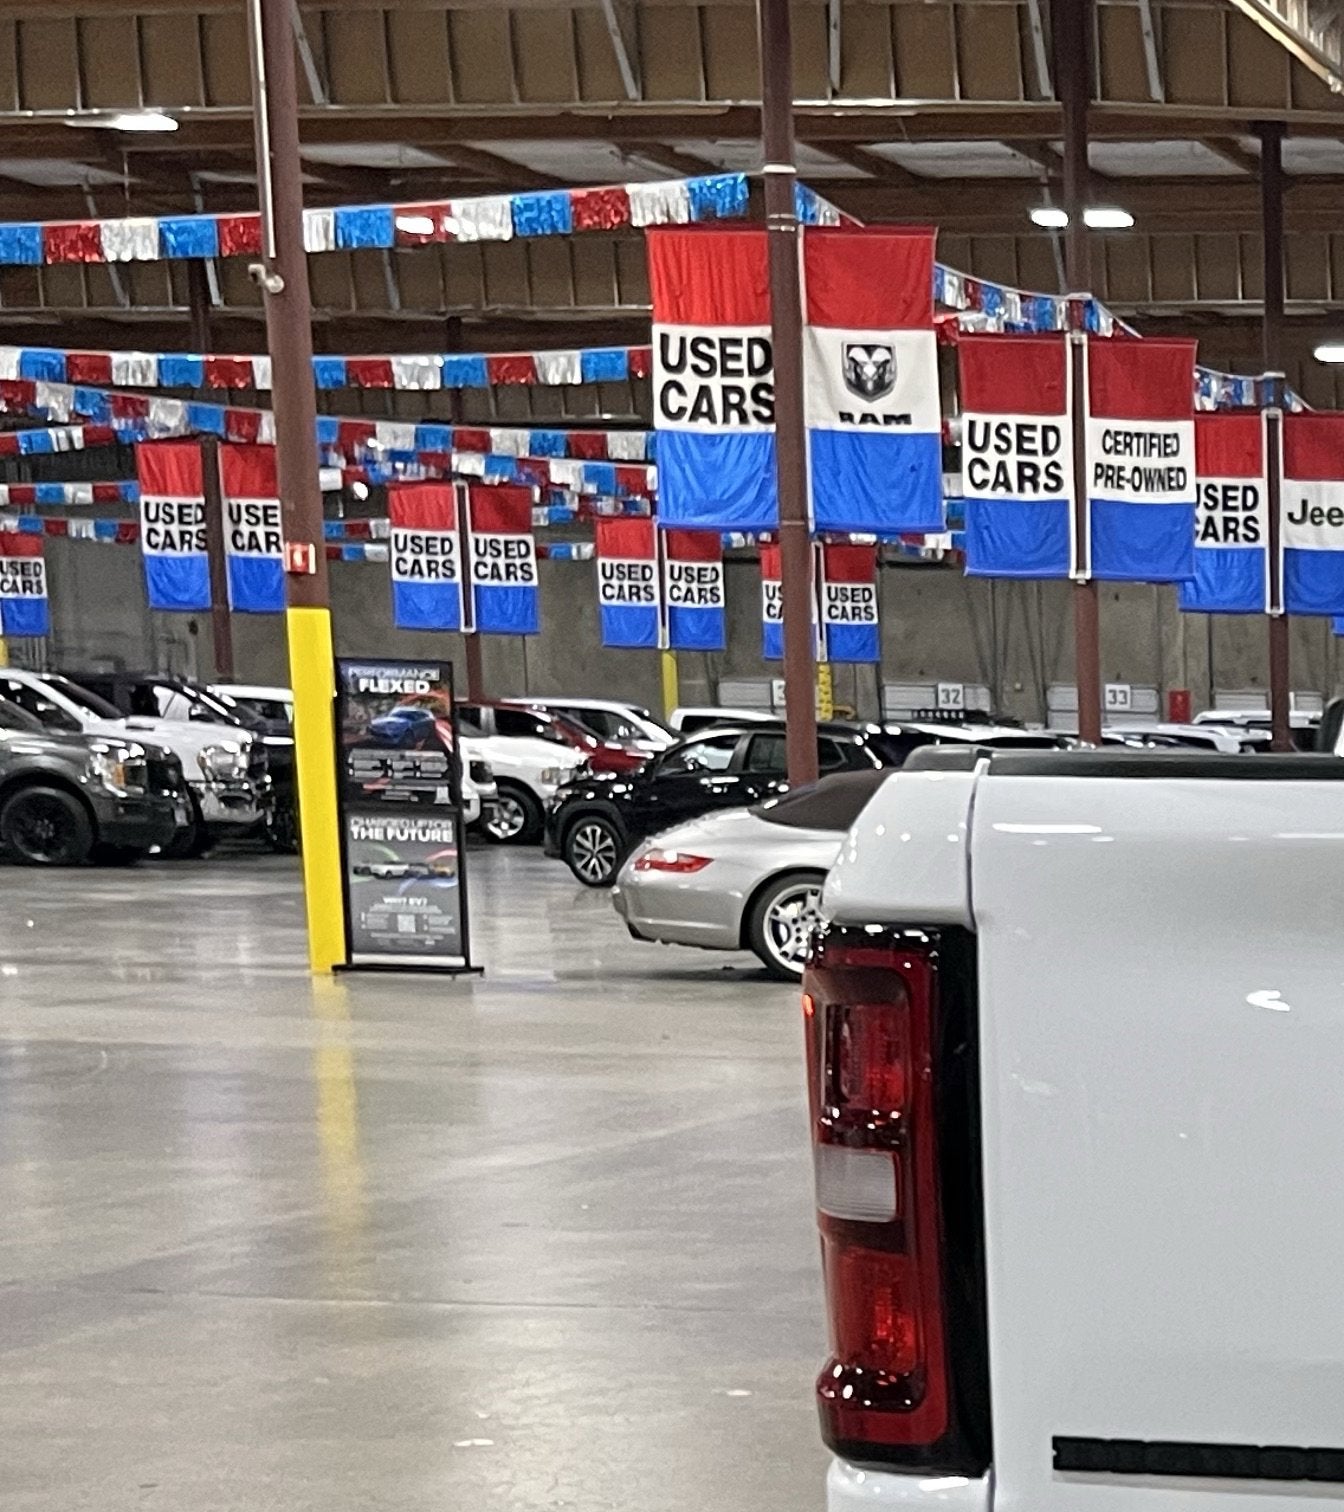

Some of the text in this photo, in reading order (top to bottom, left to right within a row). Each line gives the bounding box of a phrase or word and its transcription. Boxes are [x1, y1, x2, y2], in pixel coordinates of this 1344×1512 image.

[659, 333, 774, 378] USED
[659, 379, 776, 425] CARS
[838, 410, 913, 426] RAM
[967, 420, 1062, 457] USED
[1102, 429, 1181, 458] CERTIFIED
[967, 457, 1065, 494] CARS
[1094, 462, 1188, 493] PRE-OWNED
[144, 502, 206, 526] USED
[228, 502, 281, 527] USE
[1195, 515, 1261, 543] ARS
[145, 528, 208, 552] CARS
[231, 529, 282, 553] CAR
[394, 534, 453, 556] USED
[474, 537, 531, 559] USED
[0, 560, 42, 577] USED
[394, 557, 456, 579] CARS
[474, 561, 534, 582] CARS
[601, 562, 654, 581] USED
[669, 564, 720, 583] USED
[0, 578, 43, 595] CARS
[601, 583, 655, 601] CARS
[669, 585, 721, 604] CARS
[827, 586, 873, 604] USED
[827, 604, 875, 621] CARS
[359, 678, 431, 694] FLEXED
[940, 687, 961, 704] 32
[1107, 688, 1129, 705] 33
[351, 826, 453, 843] THE FUTURE
